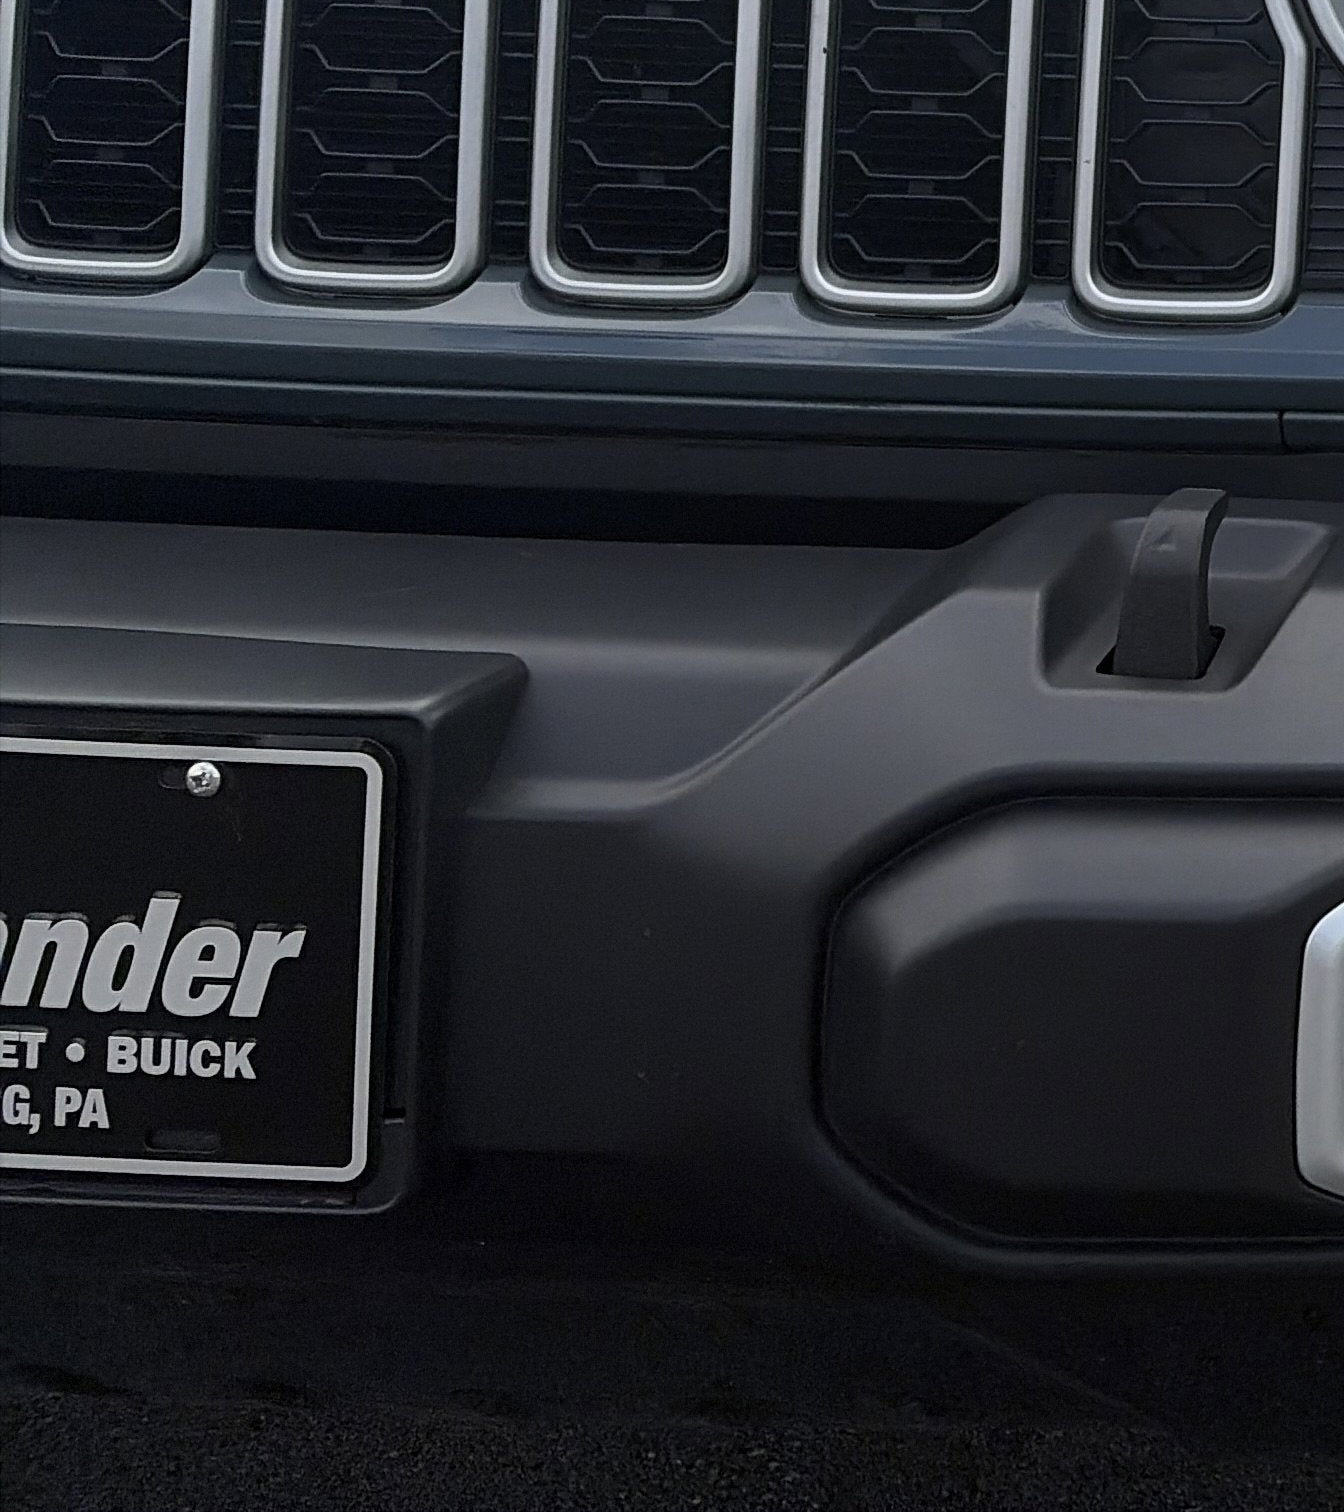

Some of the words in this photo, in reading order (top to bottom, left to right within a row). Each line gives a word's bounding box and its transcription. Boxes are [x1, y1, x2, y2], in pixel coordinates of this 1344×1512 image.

[0, 892, 308, 1018] nder
[106, 1034, 258, 1080] BUICK
[1, 1084, 41, 1135] G,
[53, 1086, 111, 1130] PA
